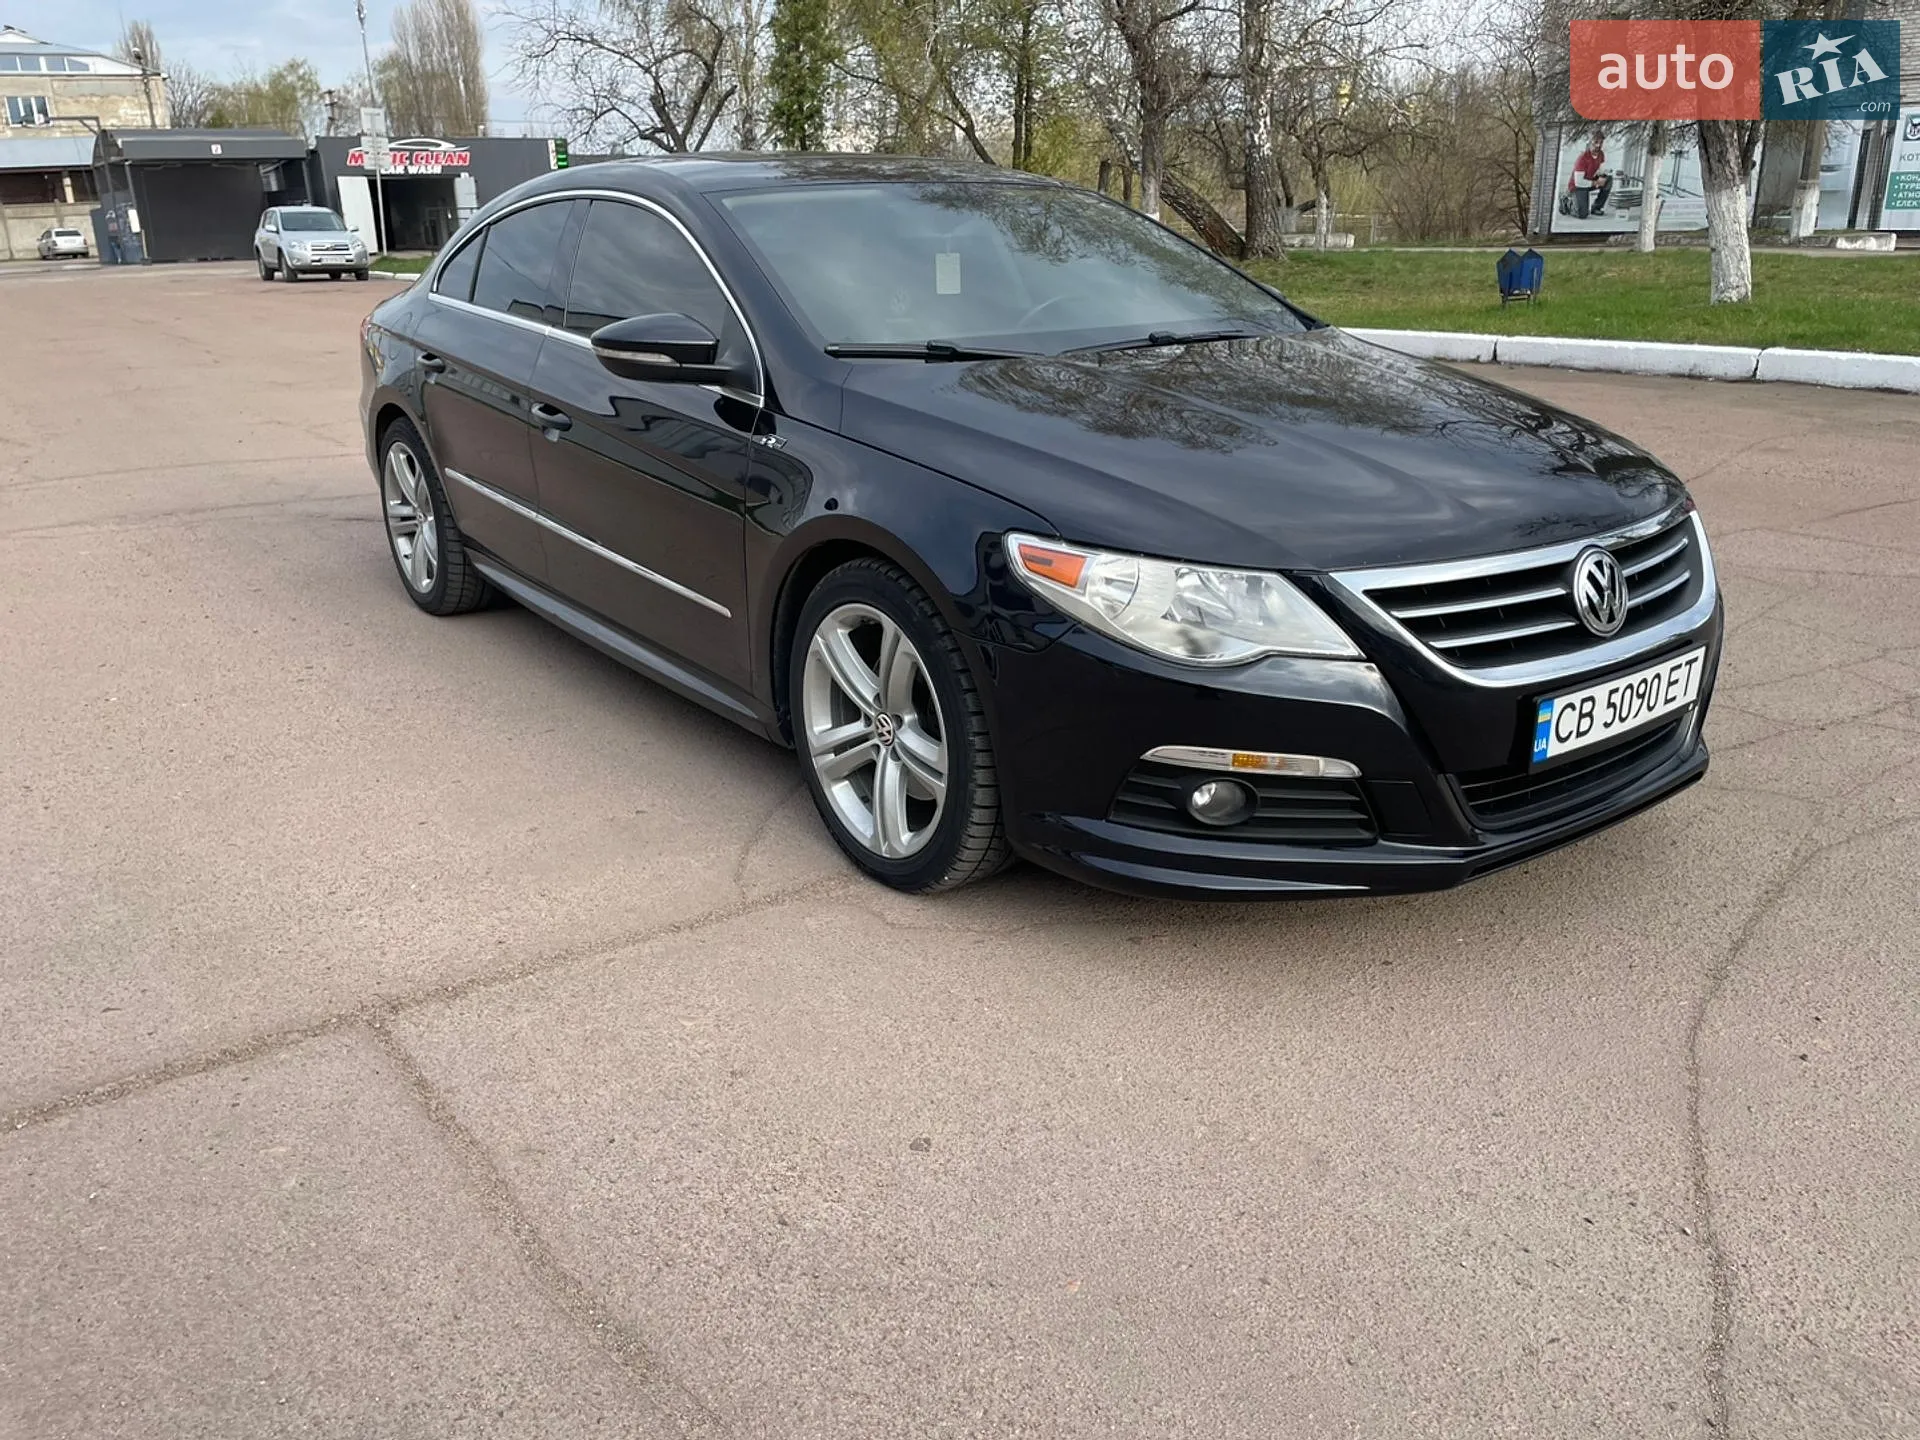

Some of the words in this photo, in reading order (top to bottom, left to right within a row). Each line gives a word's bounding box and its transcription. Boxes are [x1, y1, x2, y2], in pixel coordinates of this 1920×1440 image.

[347, 151, 409, 166] MIC
[413, 151, 470, 166] CLEAN
[407, 165, 442, 174] WASH
[1555, 695, 1596, 744] CB
[1602, 672, 1662, 729] 5090
[1663, 656, 1699, 706] ET
[1534, 738, 1547, 753] UA
